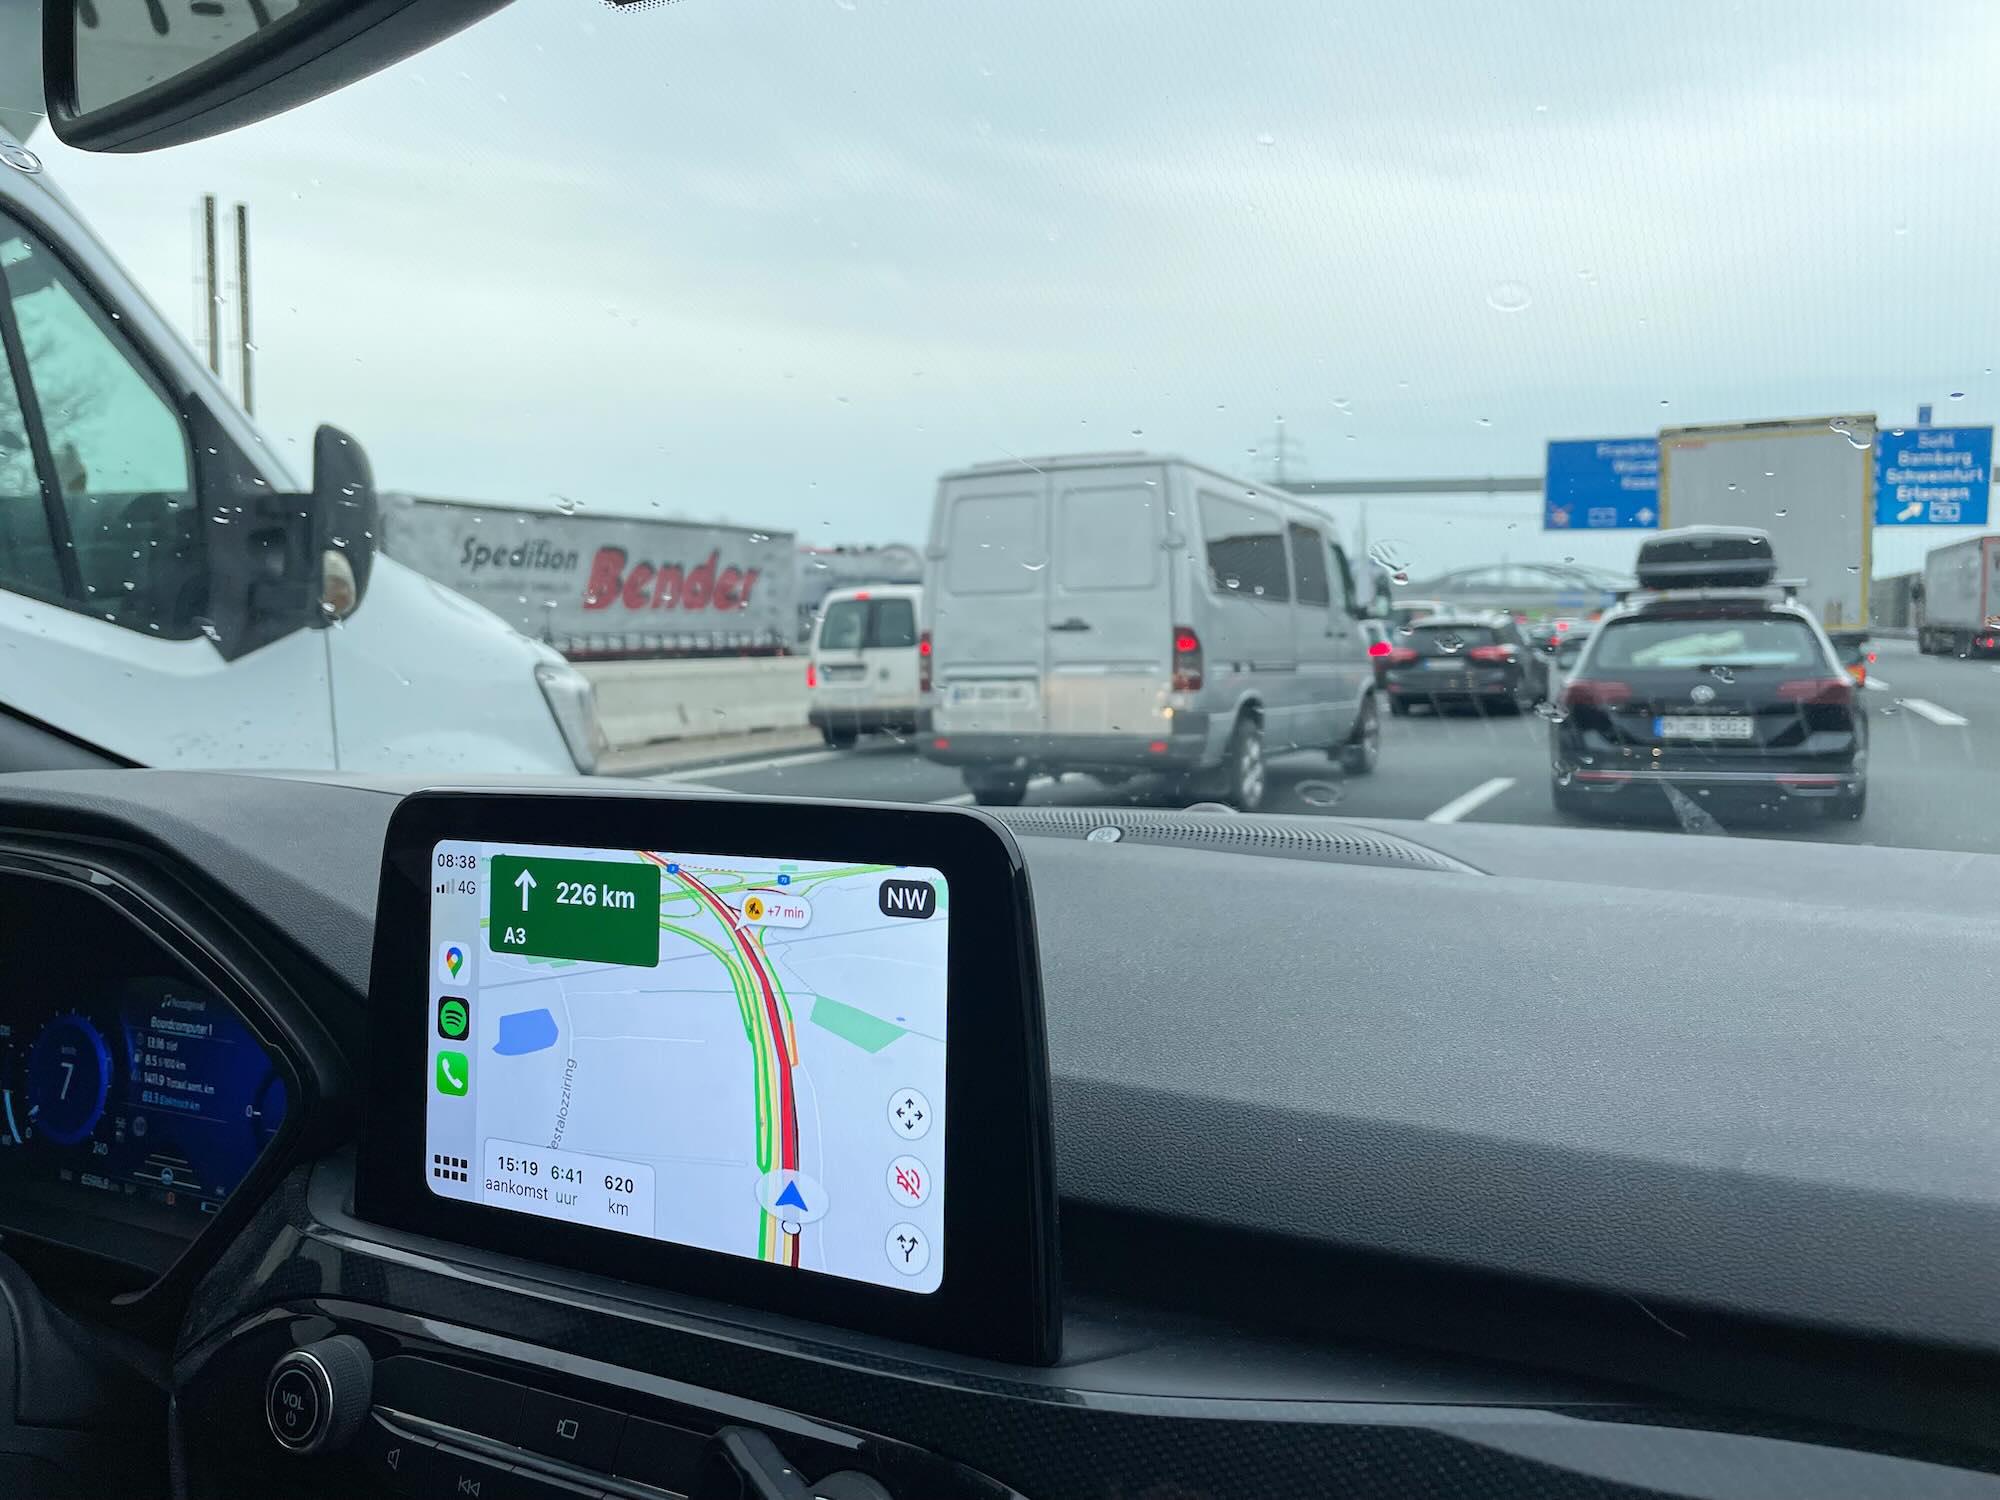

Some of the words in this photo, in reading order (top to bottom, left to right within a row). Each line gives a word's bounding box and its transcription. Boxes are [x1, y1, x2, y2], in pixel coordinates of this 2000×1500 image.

[1898, 450, 1971, 467] Bamberg
[1887, 467, 1982, 484] Schweinfurt
[1897, 485, 1970, 502] Erlangen
[460, 537, 578, 572] Spedition
[583, 545, 761, 612] Bender
[437, 854, 476, 869] 08:38
[458, 880, 476, 895] 4G
[556, 882, 597, 906] 226
[602, 884, 635, 909] km
[887, 887, 928, 911] NW
[767, 906, 780, 917] +7
[784, 906, 804, 919] min
[504, 927, 526, 944] A3
[61, 1062, 73, 1100] 7
[546, 1058, 577, 1150] estalozziring
[498, 1156, 538, 1176] 15:19
[551, 1165, 583, 1184] 6:41
[604, 1176, 634, 1193] 620
[485, 1177, 548, 1201] aankomst
[555, 1192, 578, 1206] uur
[608, 1198, 629, 1216] km
[282, 1390, 304, 1411] VOL
